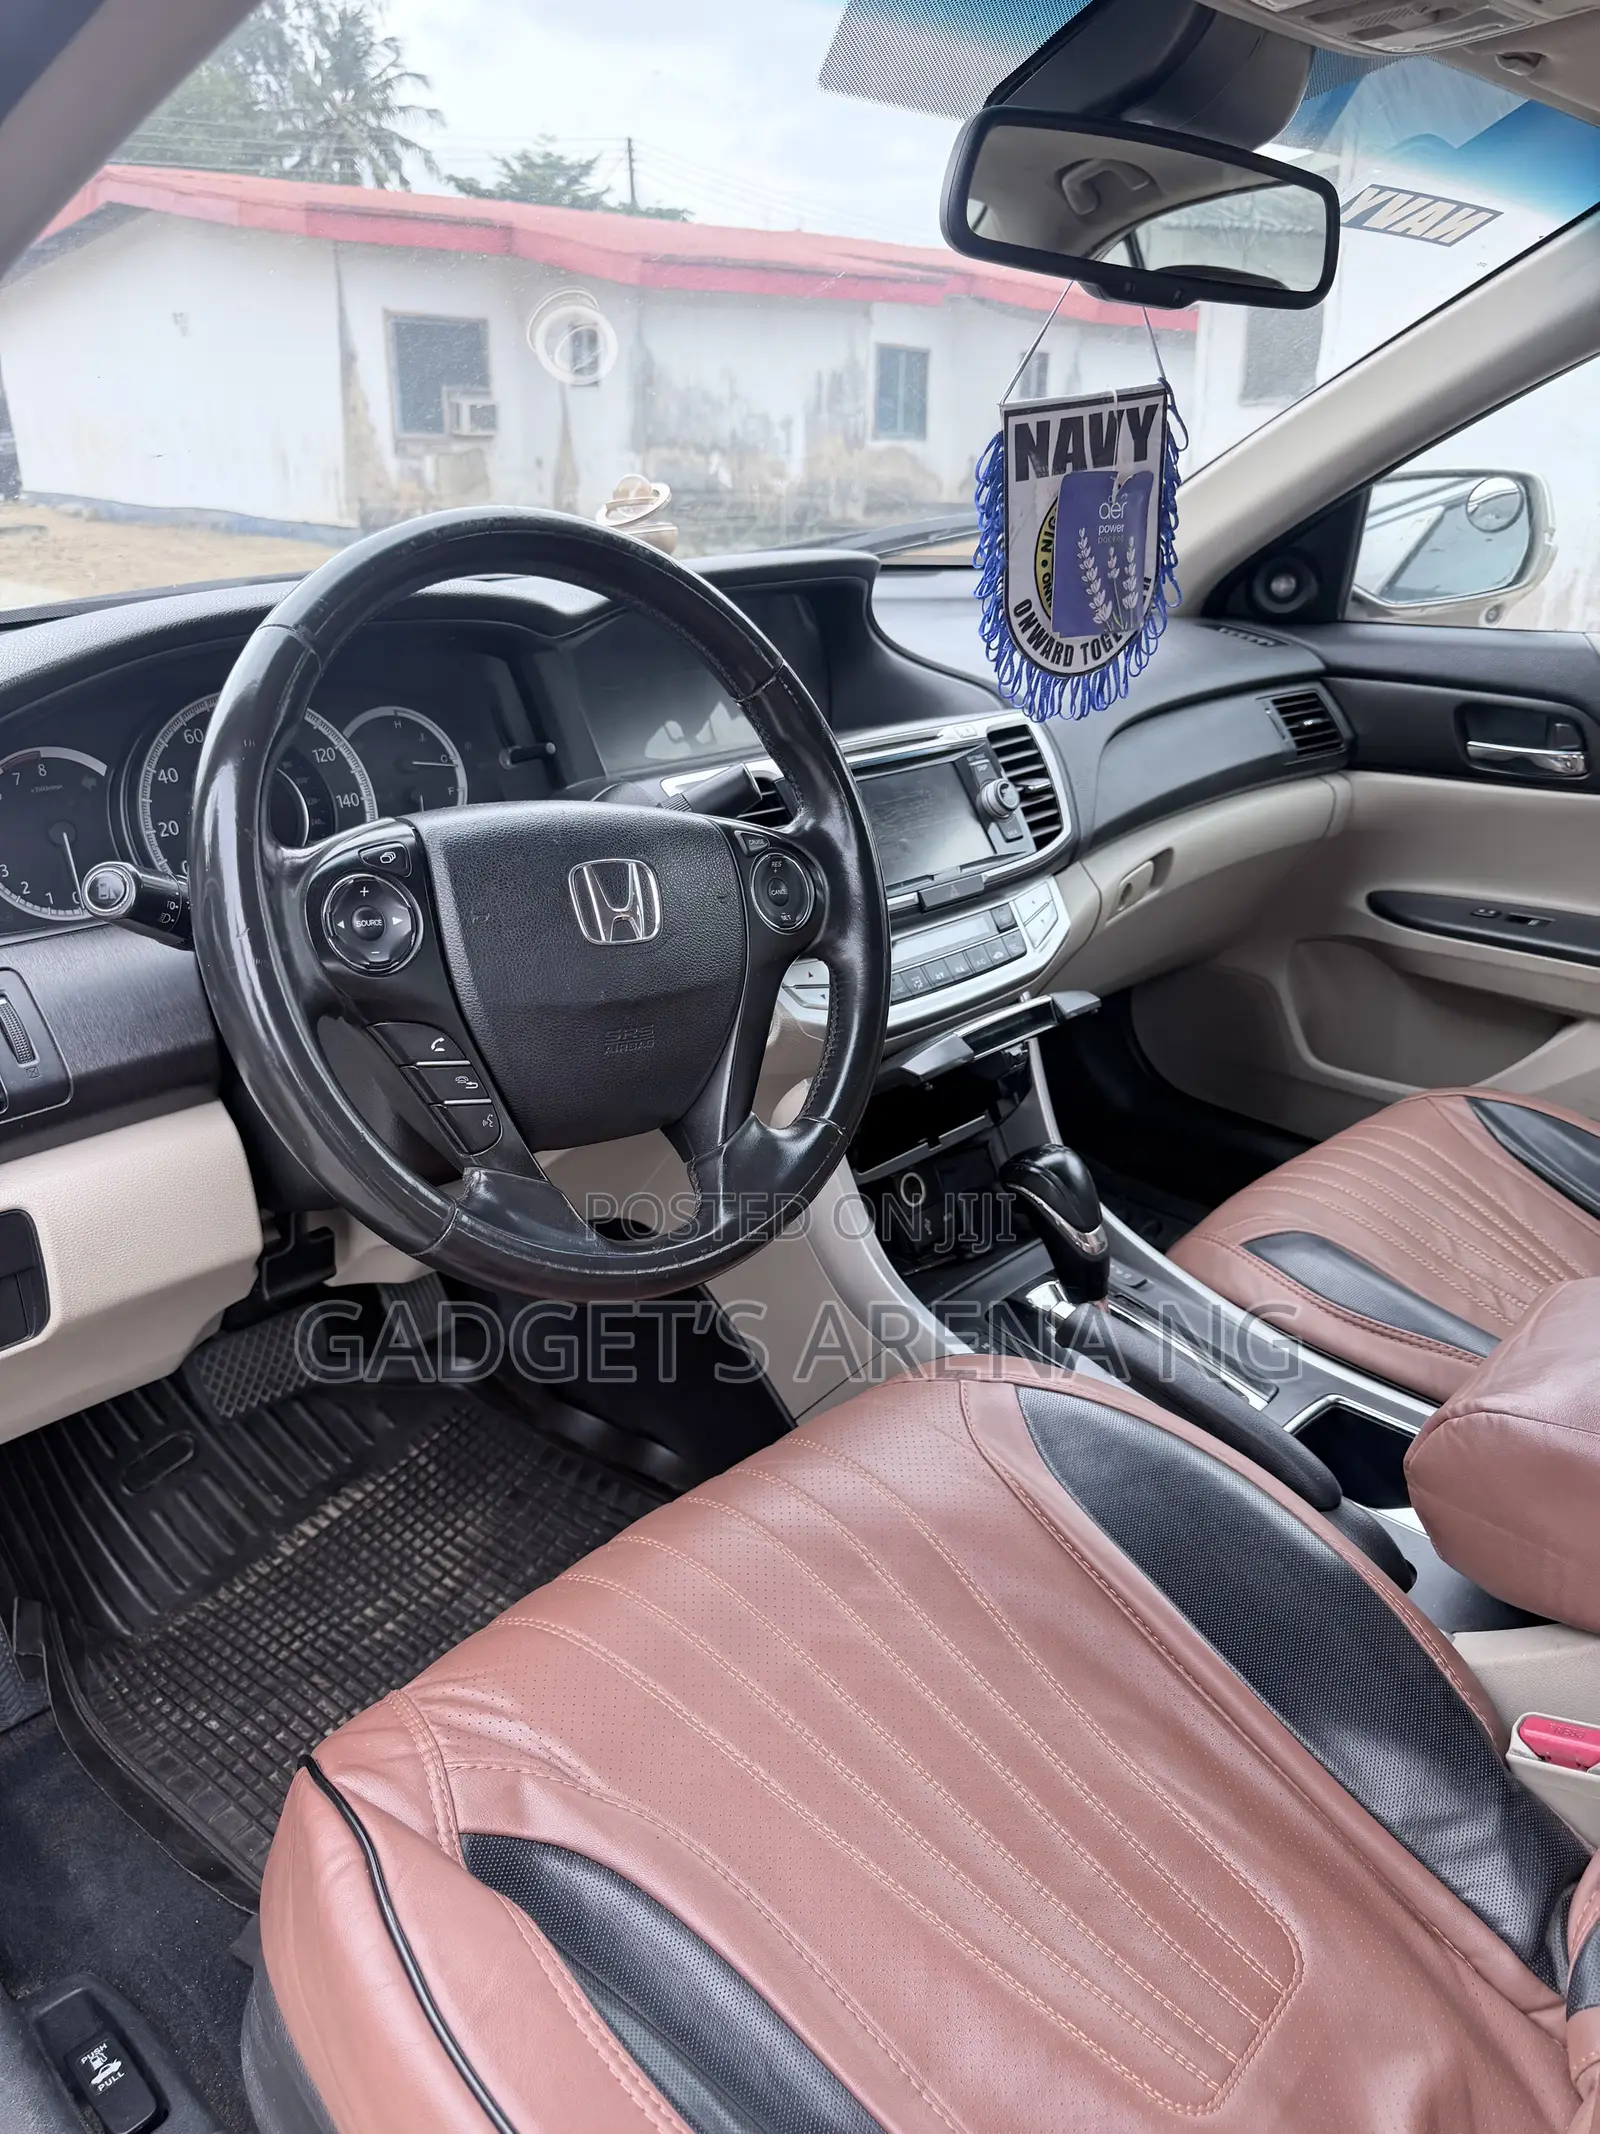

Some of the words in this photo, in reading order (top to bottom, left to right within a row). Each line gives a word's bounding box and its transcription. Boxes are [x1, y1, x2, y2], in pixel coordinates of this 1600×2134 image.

[1015, 404, 1159, 482] NAVY
[1099, 524, 1124, 536] power
[1014, 599, 1074, 667] ONWARD
[184, 728, 204, 744] 60
[312, 748, 336, 763] 120
[38, 764, 47, 776] 8
[158, 767, 179, 784] 40
[12, 772, 20, 786] 7
[336, 793, 360, 808] 140
[158, 820, 179, 837] 20
[0, 864, 9, 877] 3
[20, 881, 31, 894] 2
[45, 892, 53, 904] 1
[356, 919, 382, 928] SOURCE
[81, 2043, 107, 2064] PUSH
[98, 2072, 124, 2091] PULL
